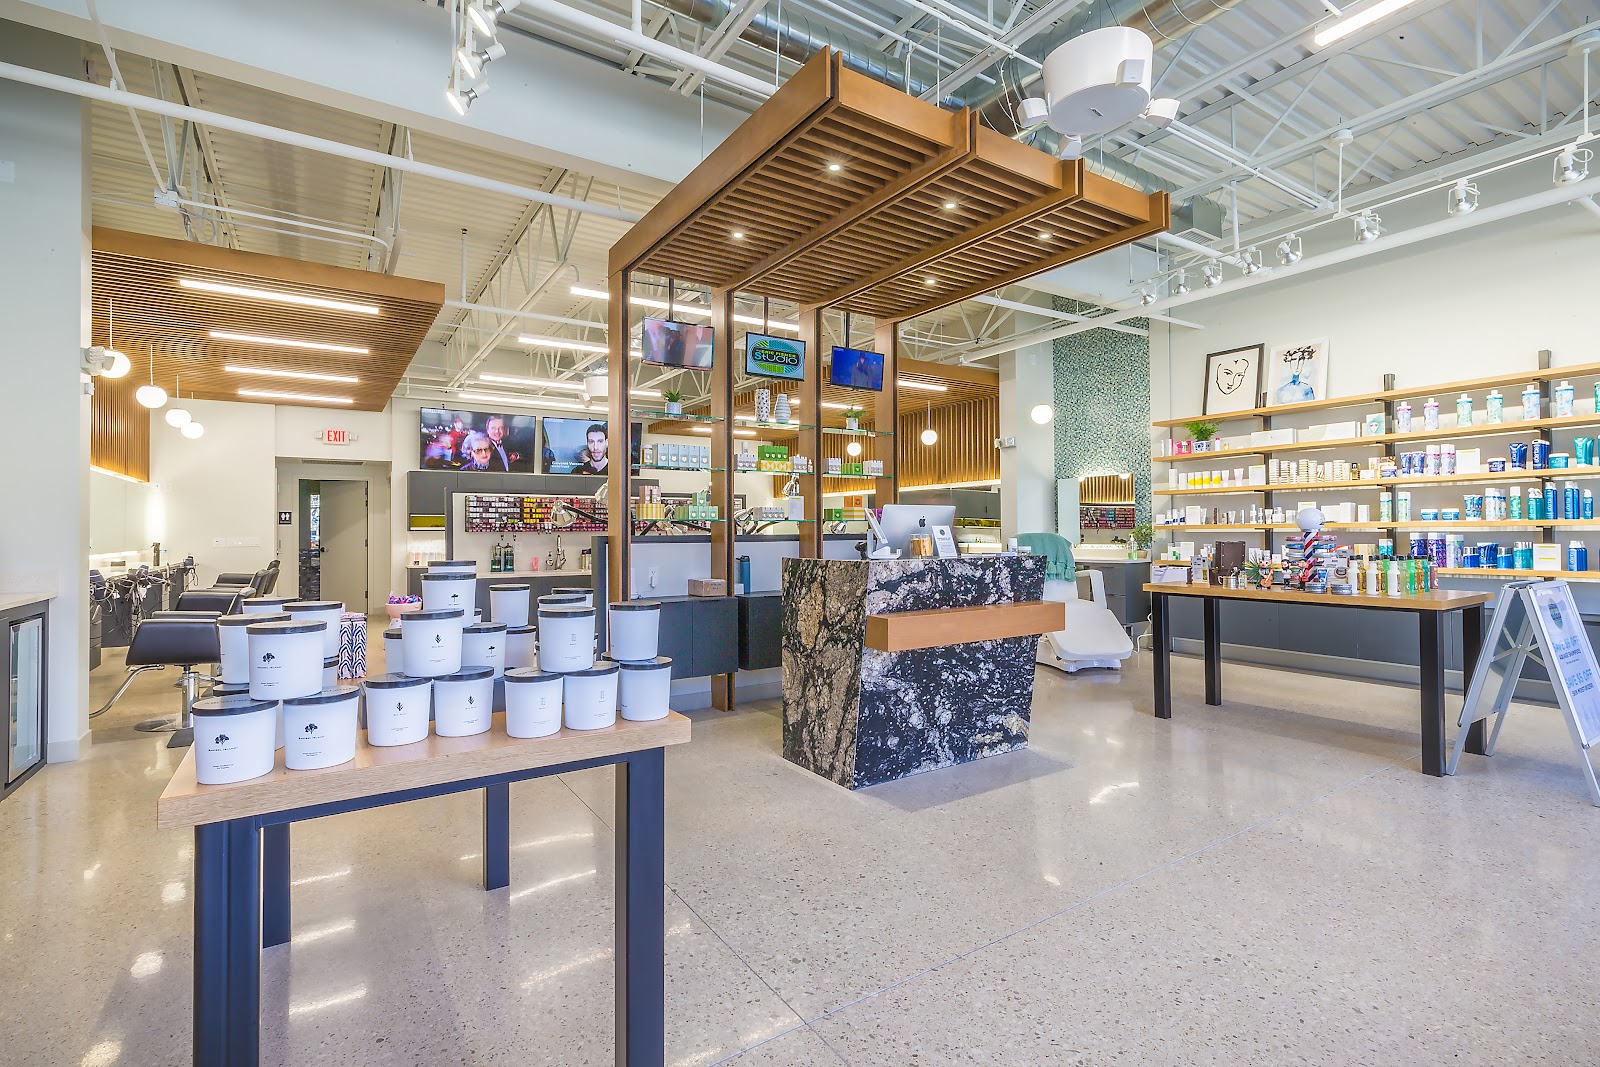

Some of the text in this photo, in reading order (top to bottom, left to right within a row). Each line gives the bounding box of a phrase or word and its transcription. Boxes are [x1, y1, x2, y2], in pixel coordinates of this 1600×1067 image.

[754, 351, 798, 364] Studio
[327, 430, 346, 442] EXIT
[1582, 668, 1592, 681] OFF
